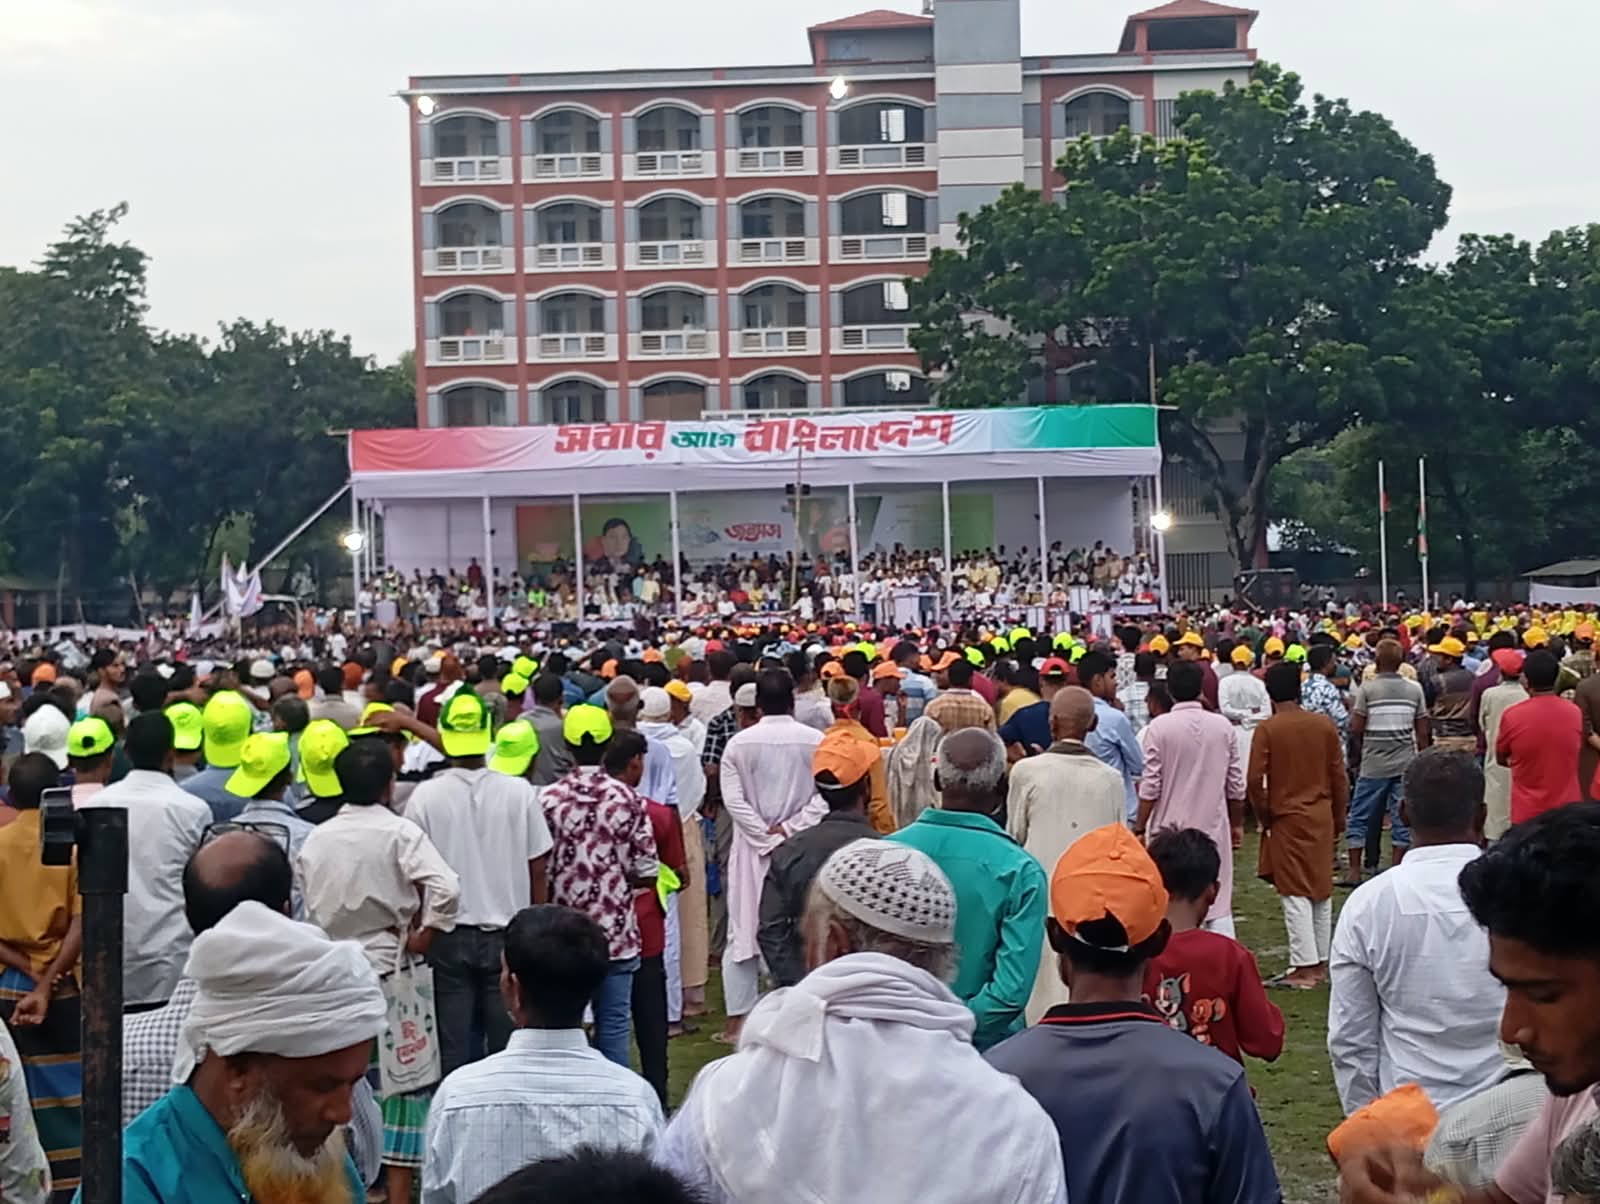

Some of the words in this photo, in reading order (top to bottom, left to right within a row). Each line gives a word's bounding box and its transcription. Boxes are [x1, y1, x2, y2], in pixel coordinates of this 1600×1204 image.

[554, 421, 668, 460] সবার
[671, 431, 736, 448] আগে
[743, 414, 954, 453] বাংলাদেশ
